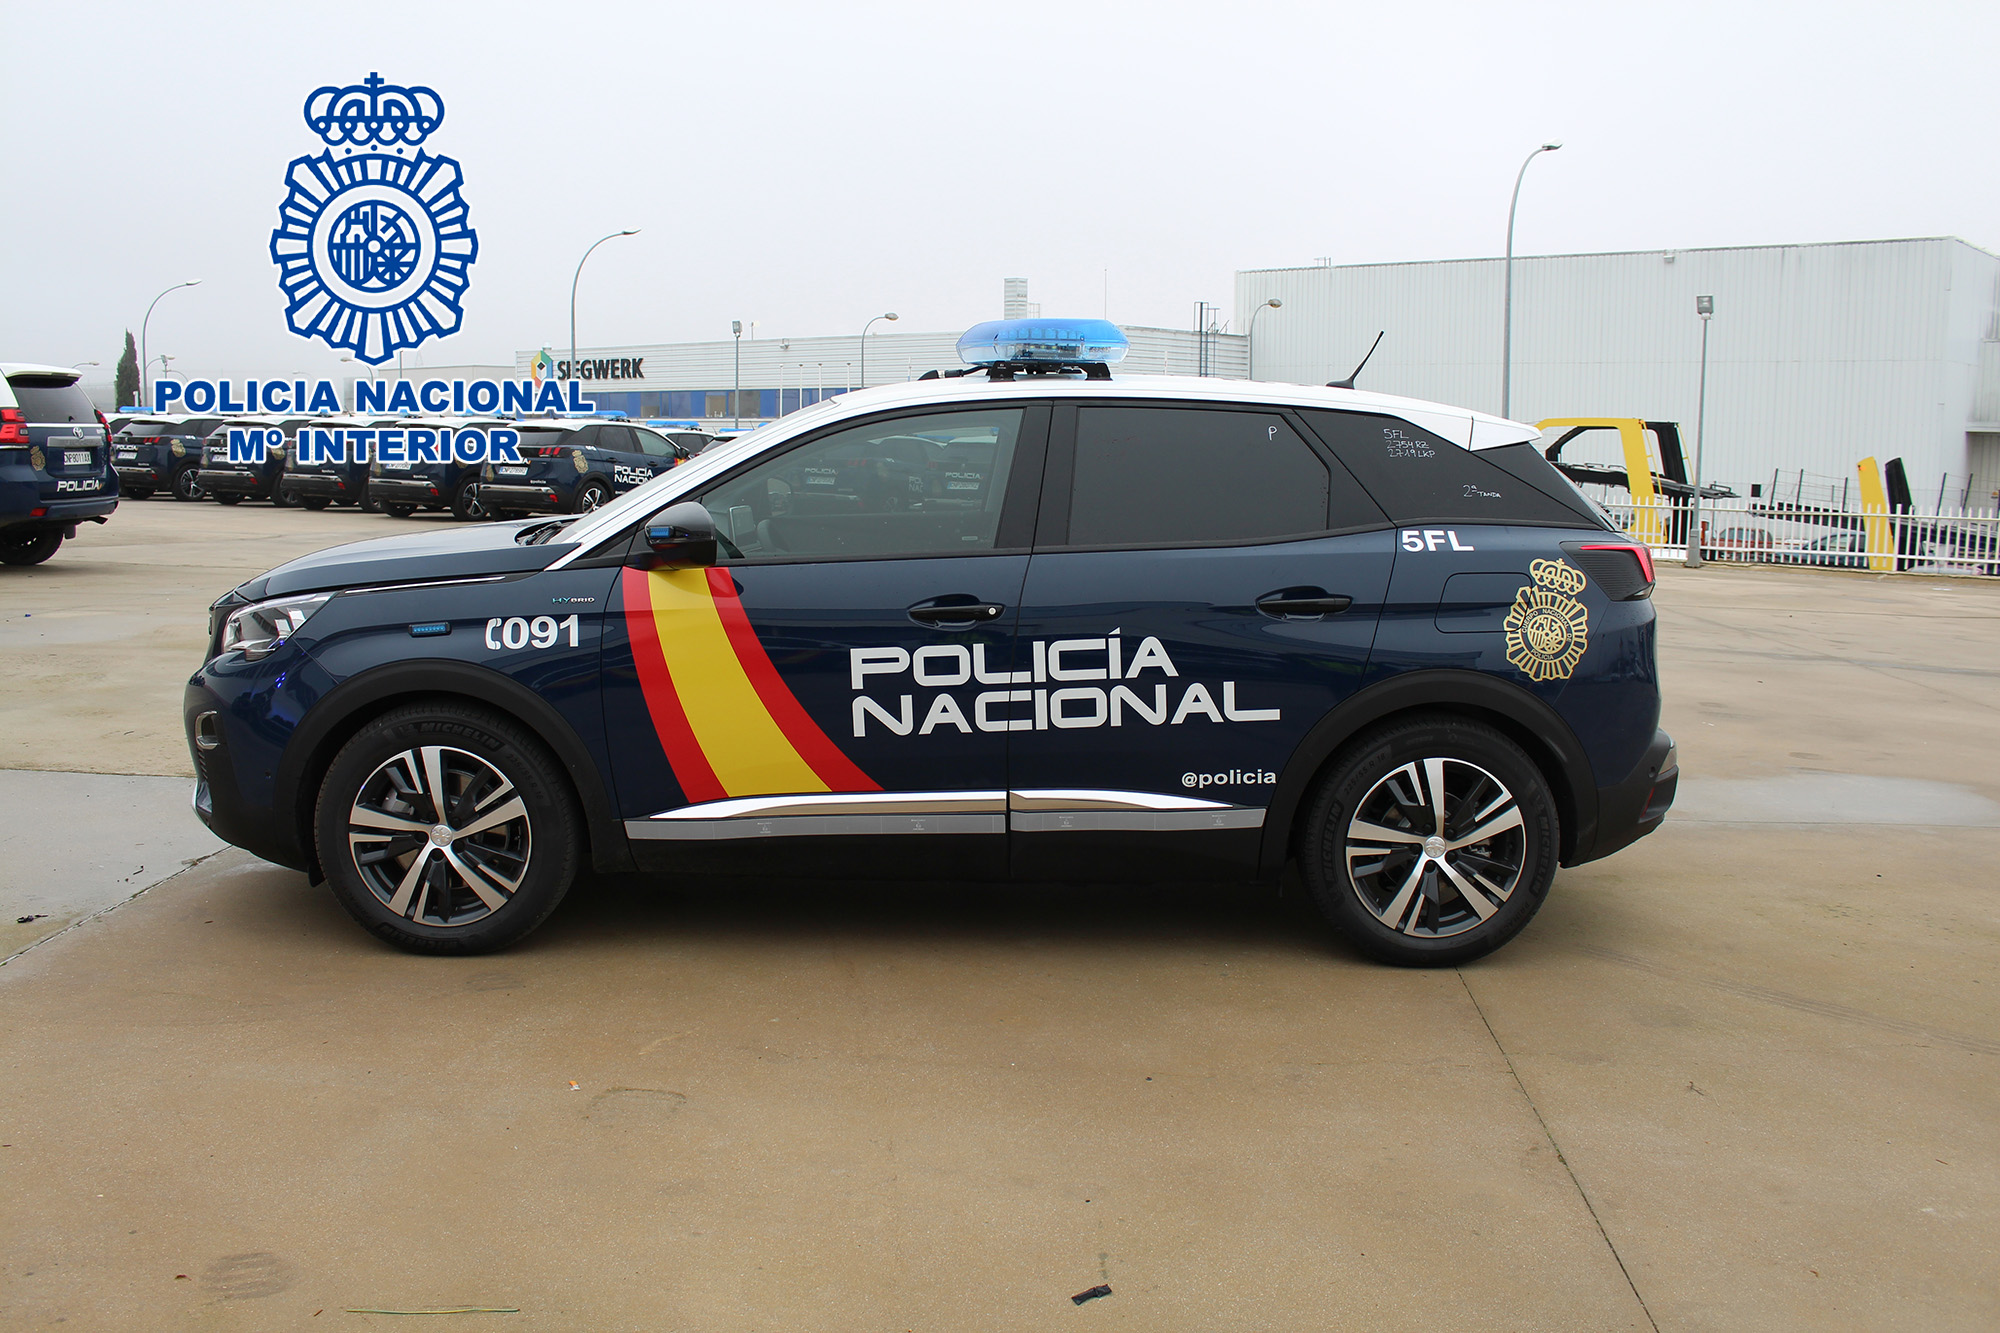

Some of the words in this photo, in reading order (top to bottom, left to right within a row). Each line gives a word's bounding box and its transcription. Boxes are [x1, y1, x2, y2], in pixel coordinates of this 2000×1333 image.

[1267, 425, 1278, 441] P
[1383, 428, 1409, 439] 5FL
[614, 474, 652, 485] NACIO
[1401, 529, 1475, 553] 5FL
[502, 614, 580, 651] 091
[1522, 610, 1539, 634] CUERPO
[1542, 608, 1569, 629] NACIONAL
[849, 626, 1179, 690] POLICÍA
[851, 681, 1281, 738] NACIONAL
[420, 722, 501, 750] MICHELIN
[1181, 769, 1277, 789] @policia
